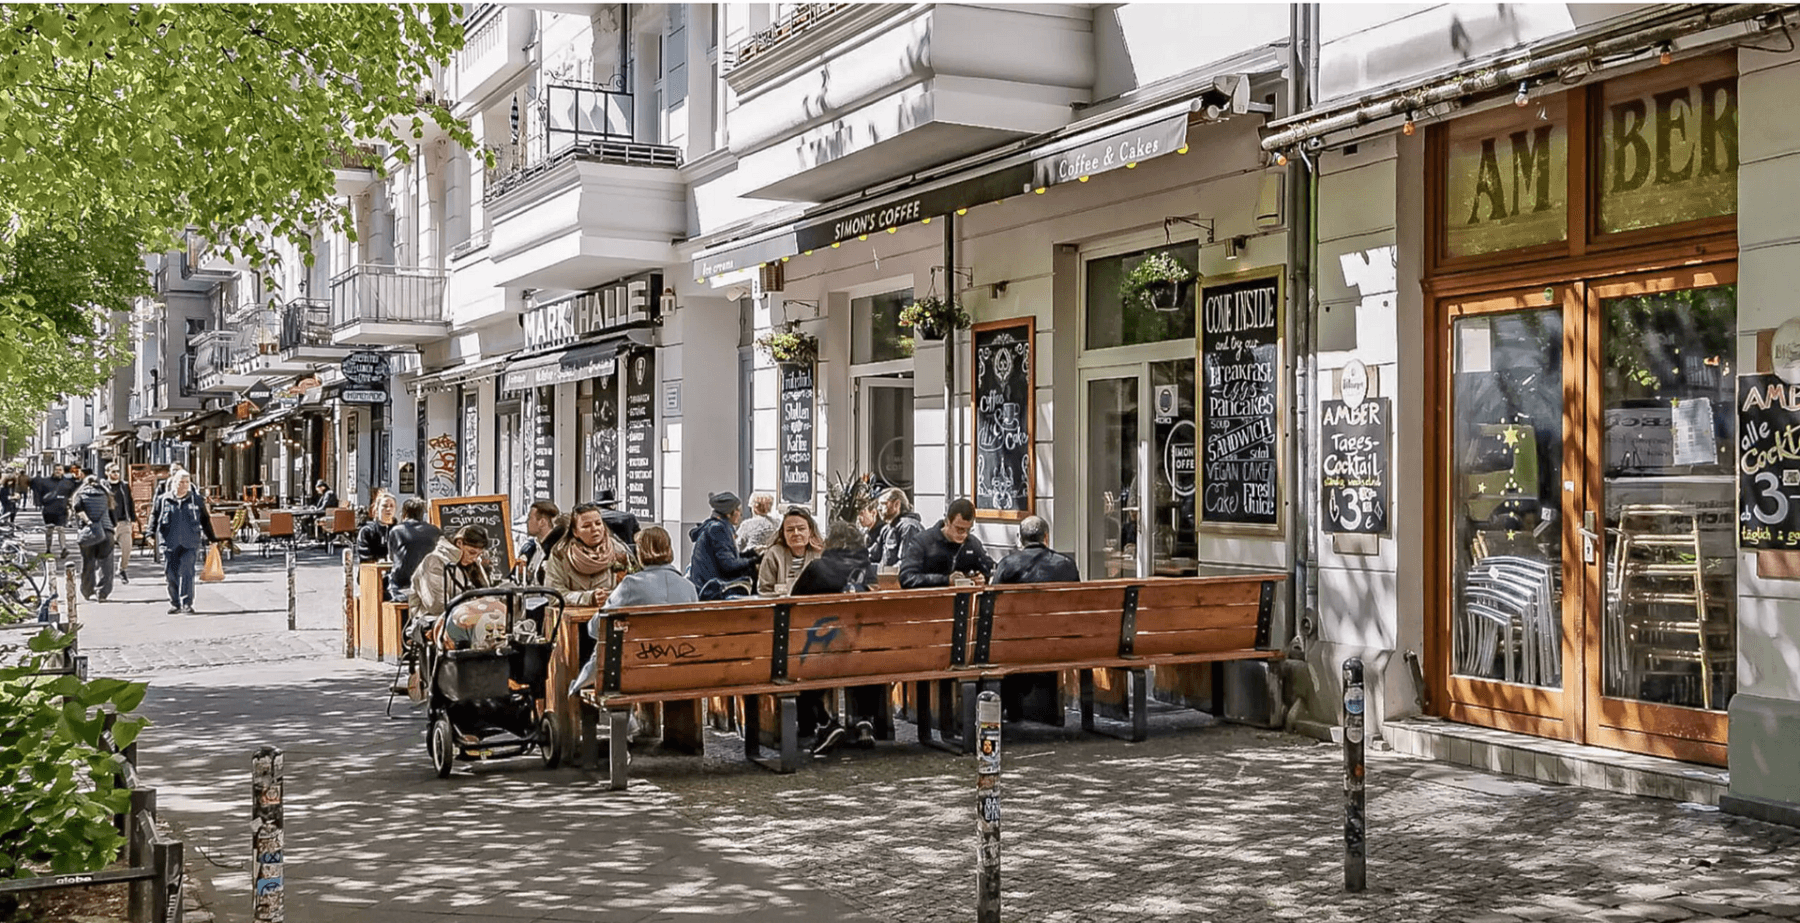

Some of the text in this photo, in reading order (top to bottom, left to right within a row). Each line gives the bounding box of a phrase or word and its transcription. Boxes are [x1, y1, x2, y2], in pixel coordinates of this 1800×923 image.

[1059, 137, 1159, 178] Coffee & Cakes
[1467, 78, 1738, 224] AM BER
[834, 200, 920, 241] SIMON'S COFFEE
[1206, 287, 1276, 334] COME INSIDE
[1209, 393, 1274, 417] Pancakes
[1322, 402, 1381, 426] AMBER
[787, 434, 808, 452] Kaffee
[1207, 417, 1273, 462] SANDWICH
[1331, 433, 1380, 456] Tages-
[1741, 420, 1771, 451] alle
[1741, 424, 1800, 475] Cockt
[784, 465, 809, 484] Kuchen
[1205, 462, 1239, 481] VEGAN
[1323, 452, 1383, 479] Cocktail
[1204, 482, 1240, 515] Cake
[1340, 487, 1362, 531] 3
[1753, 471, 1789, 525] 3
